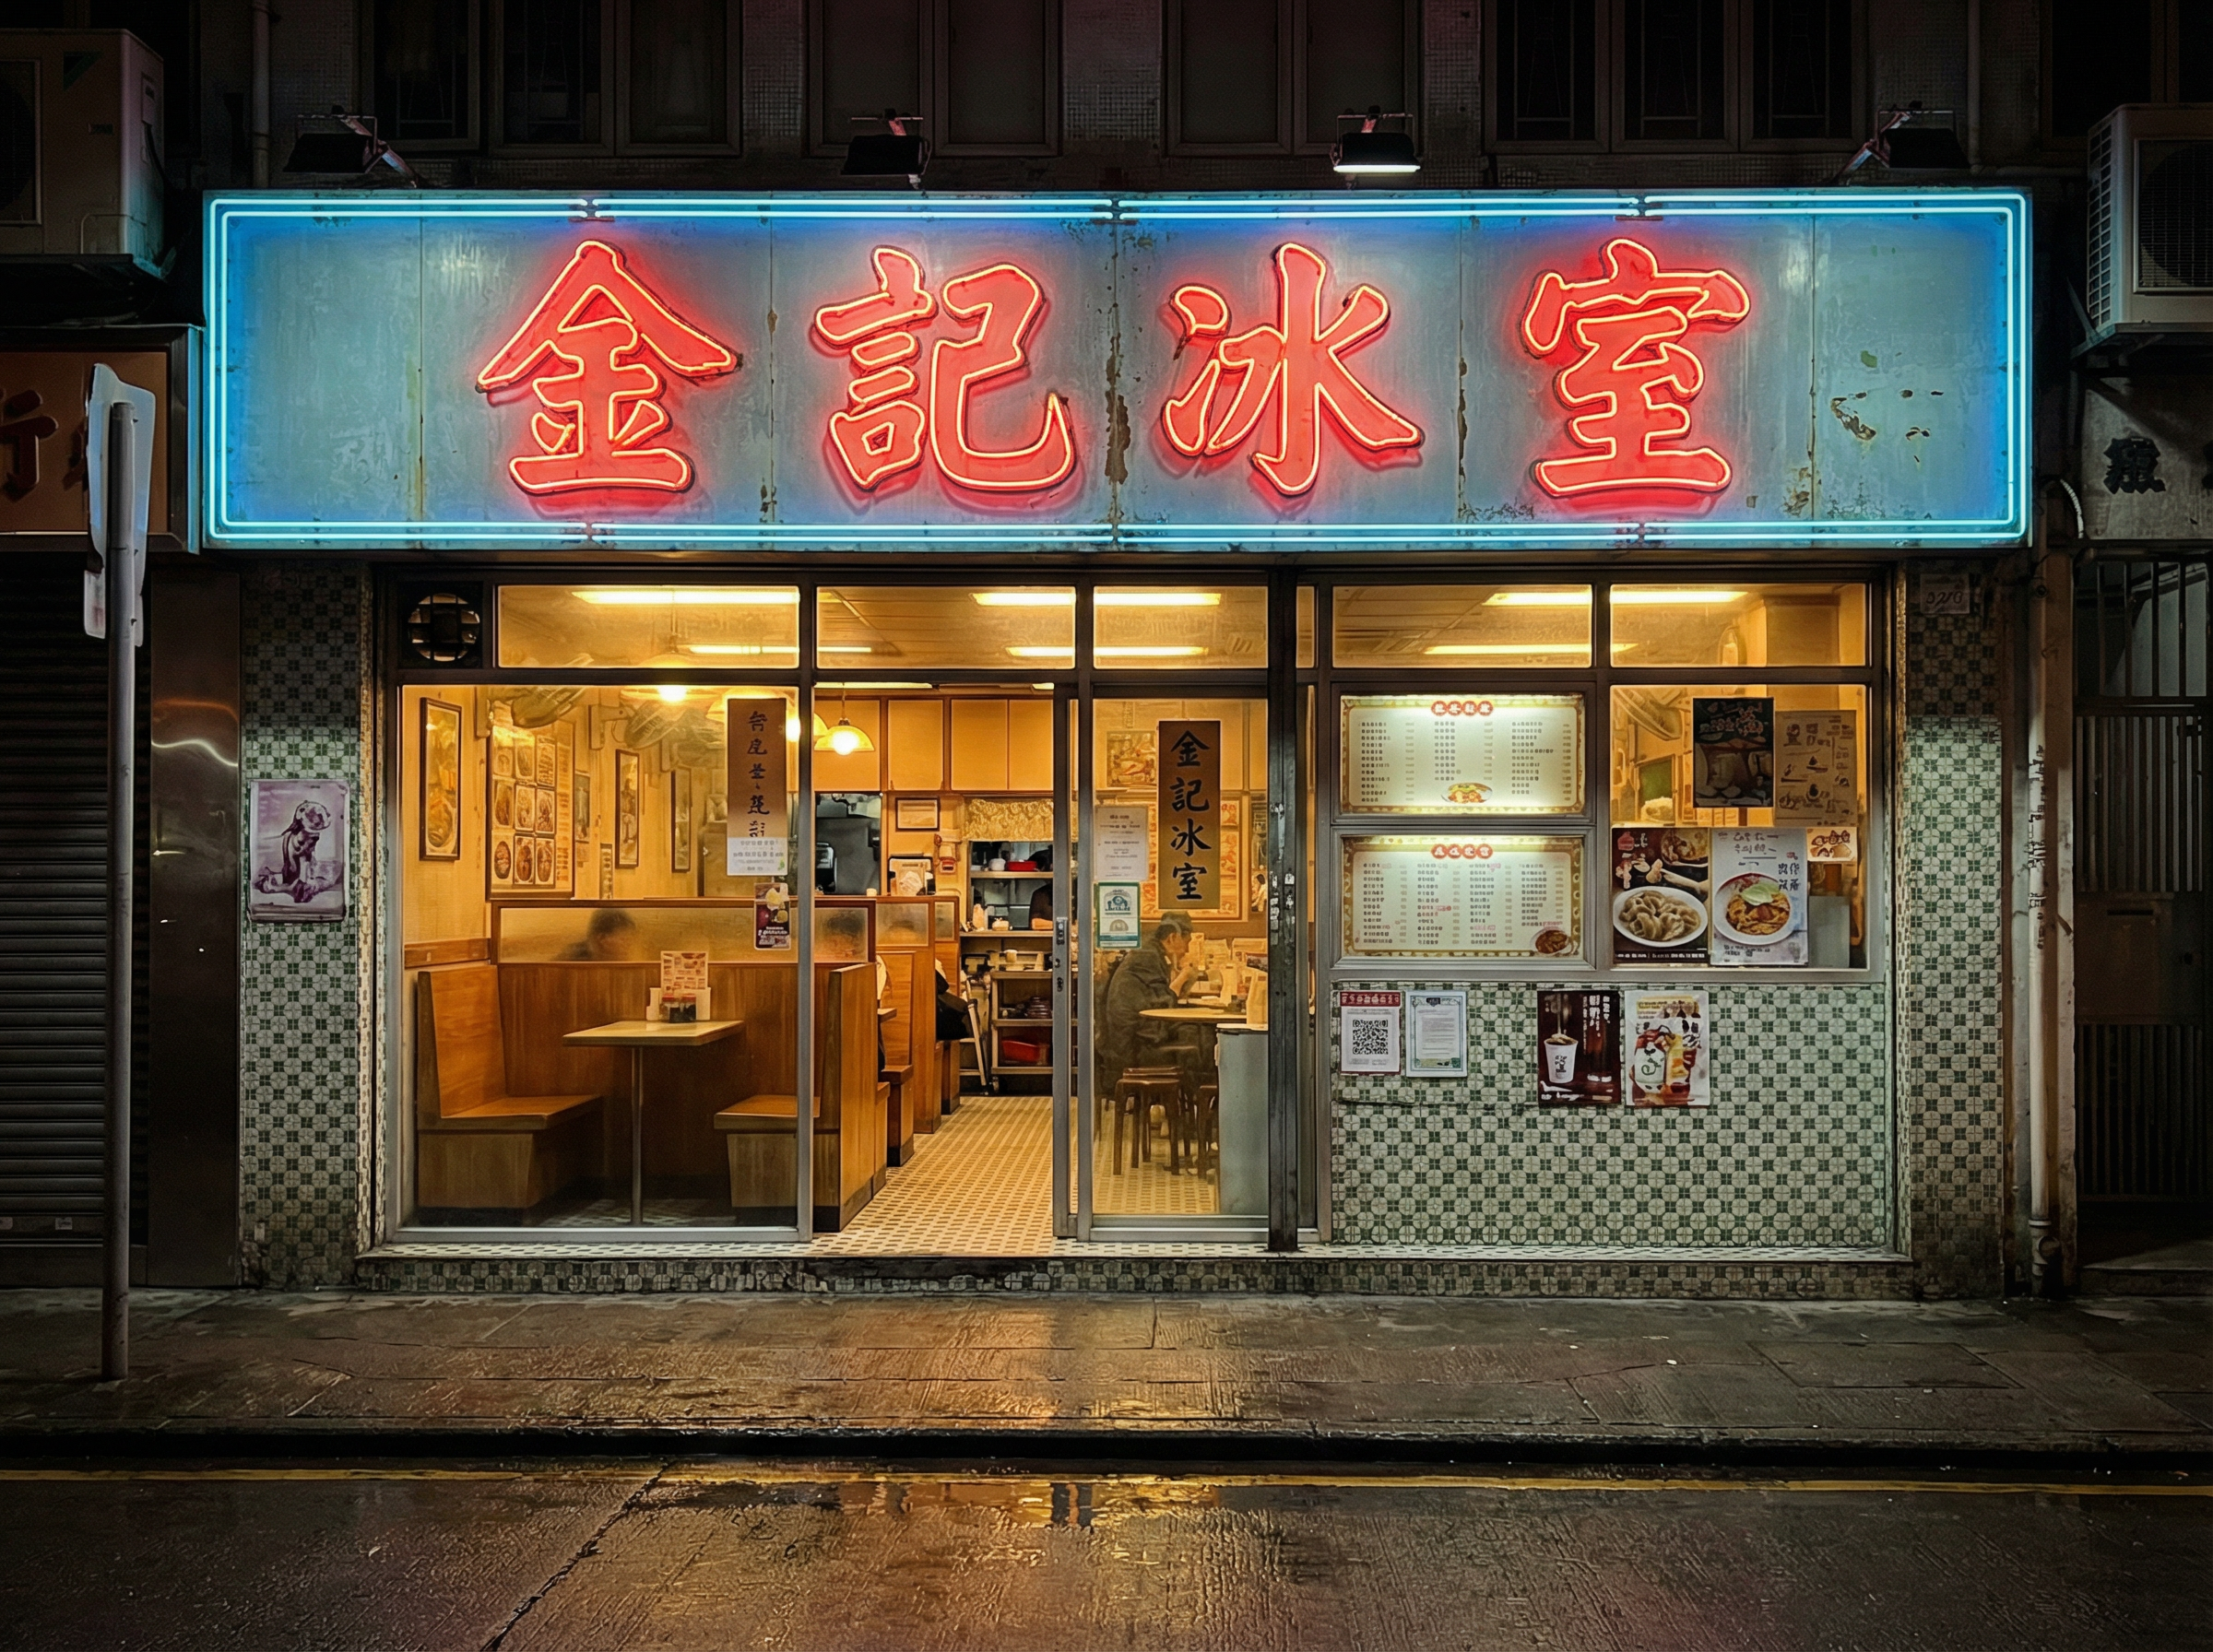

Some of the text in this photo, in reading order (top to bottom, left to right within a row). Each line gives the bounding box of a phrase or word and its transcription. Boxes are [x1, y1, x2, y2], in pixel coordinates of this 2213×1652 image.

[476, 239, 1751, 496] 金記冰室
[1169, 729, 1213, 901] 金記冰室
